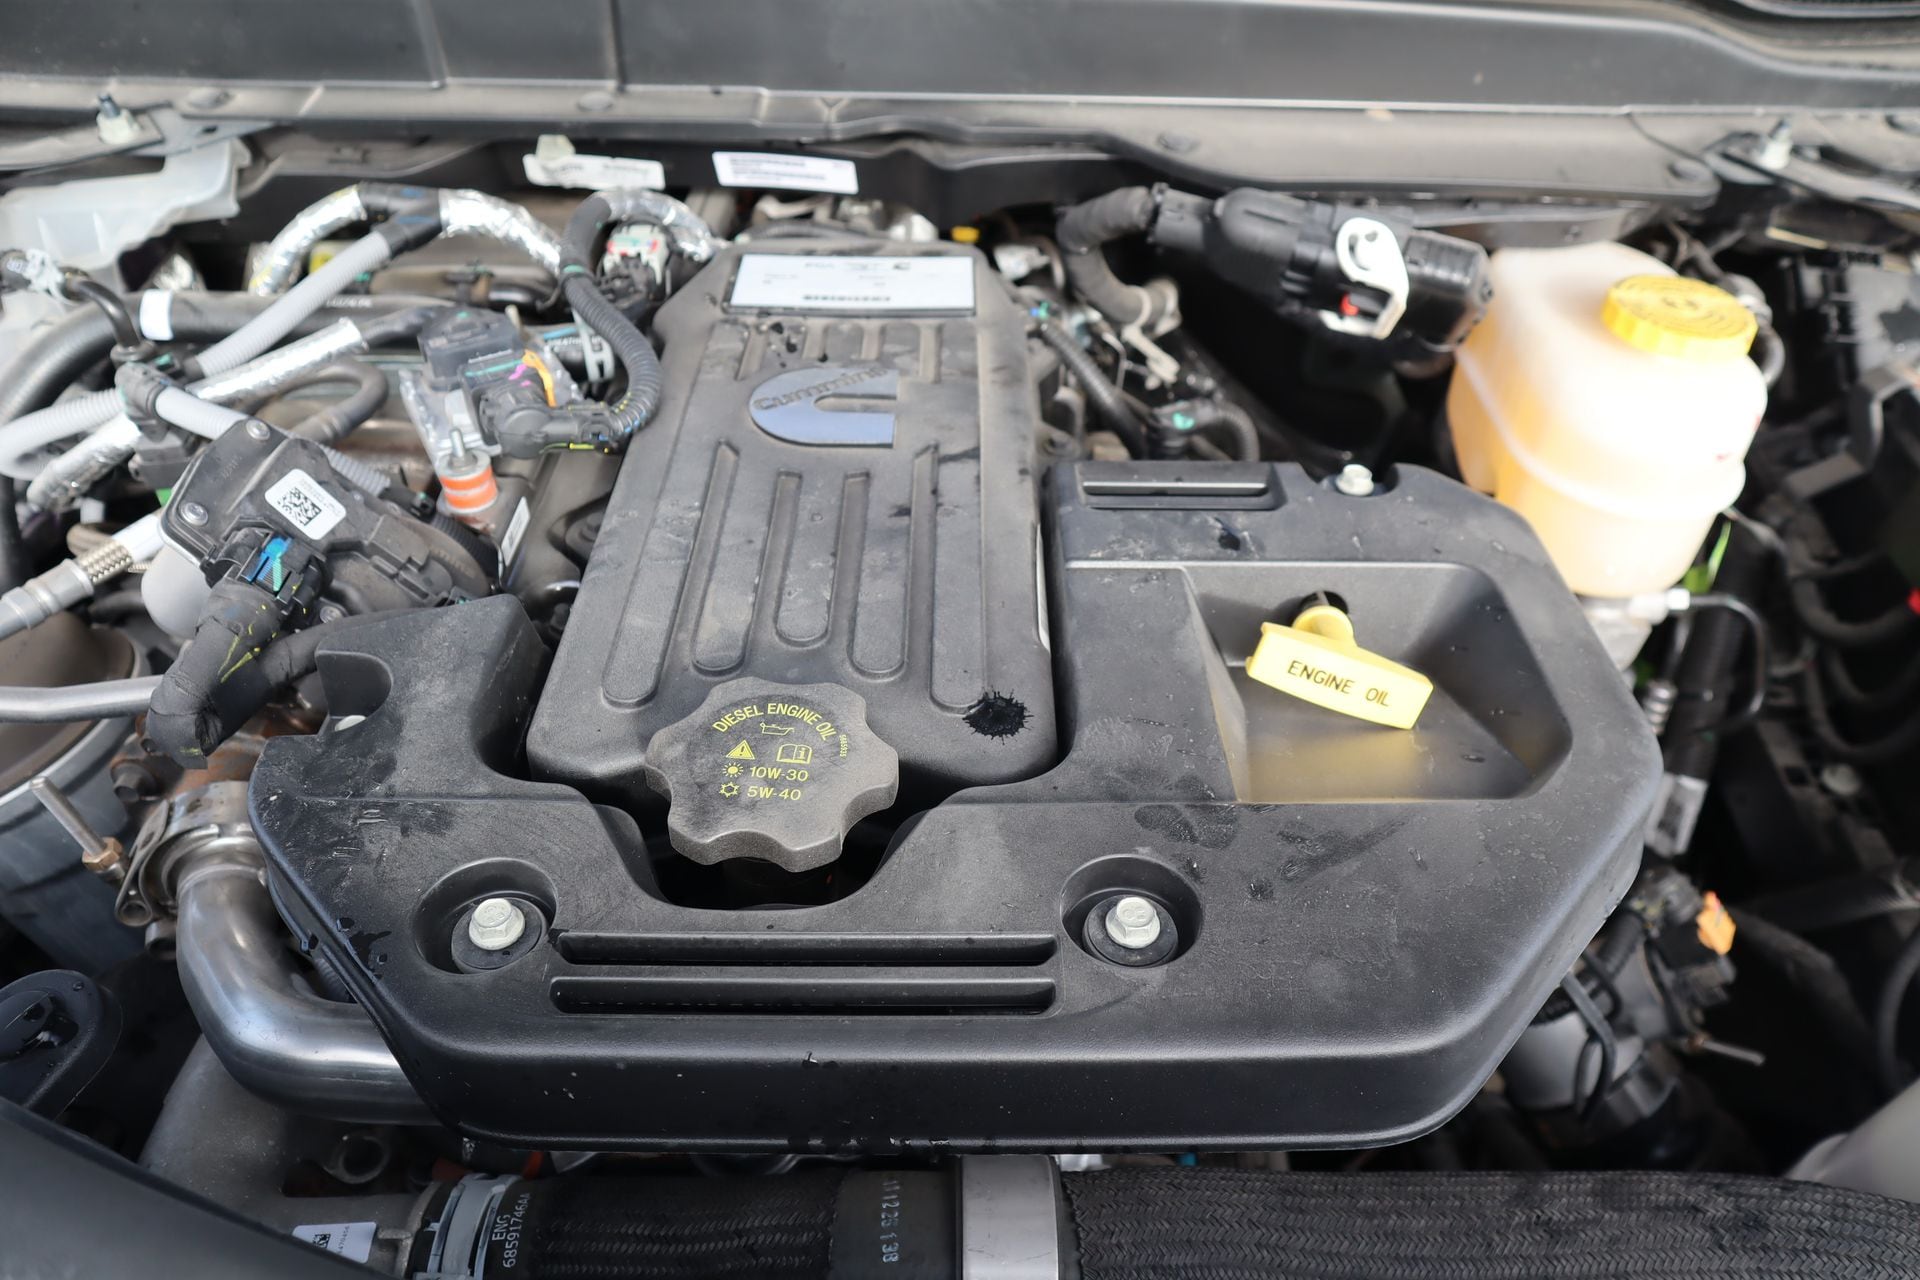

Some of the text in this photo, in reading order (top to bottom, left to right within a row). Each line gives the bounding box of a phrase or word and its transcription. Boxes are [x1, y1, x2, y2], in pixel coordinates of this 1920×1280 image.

[1287, 660, 1390, 707] ENGINE OIL
[712, 703, 837, 741] DIESEL ENGINE OIL
[749, 766, 809, 781] 10W-30
[747, 785, 801, 800] 5W-40
[492, 1214, 511, 1241] ENG
